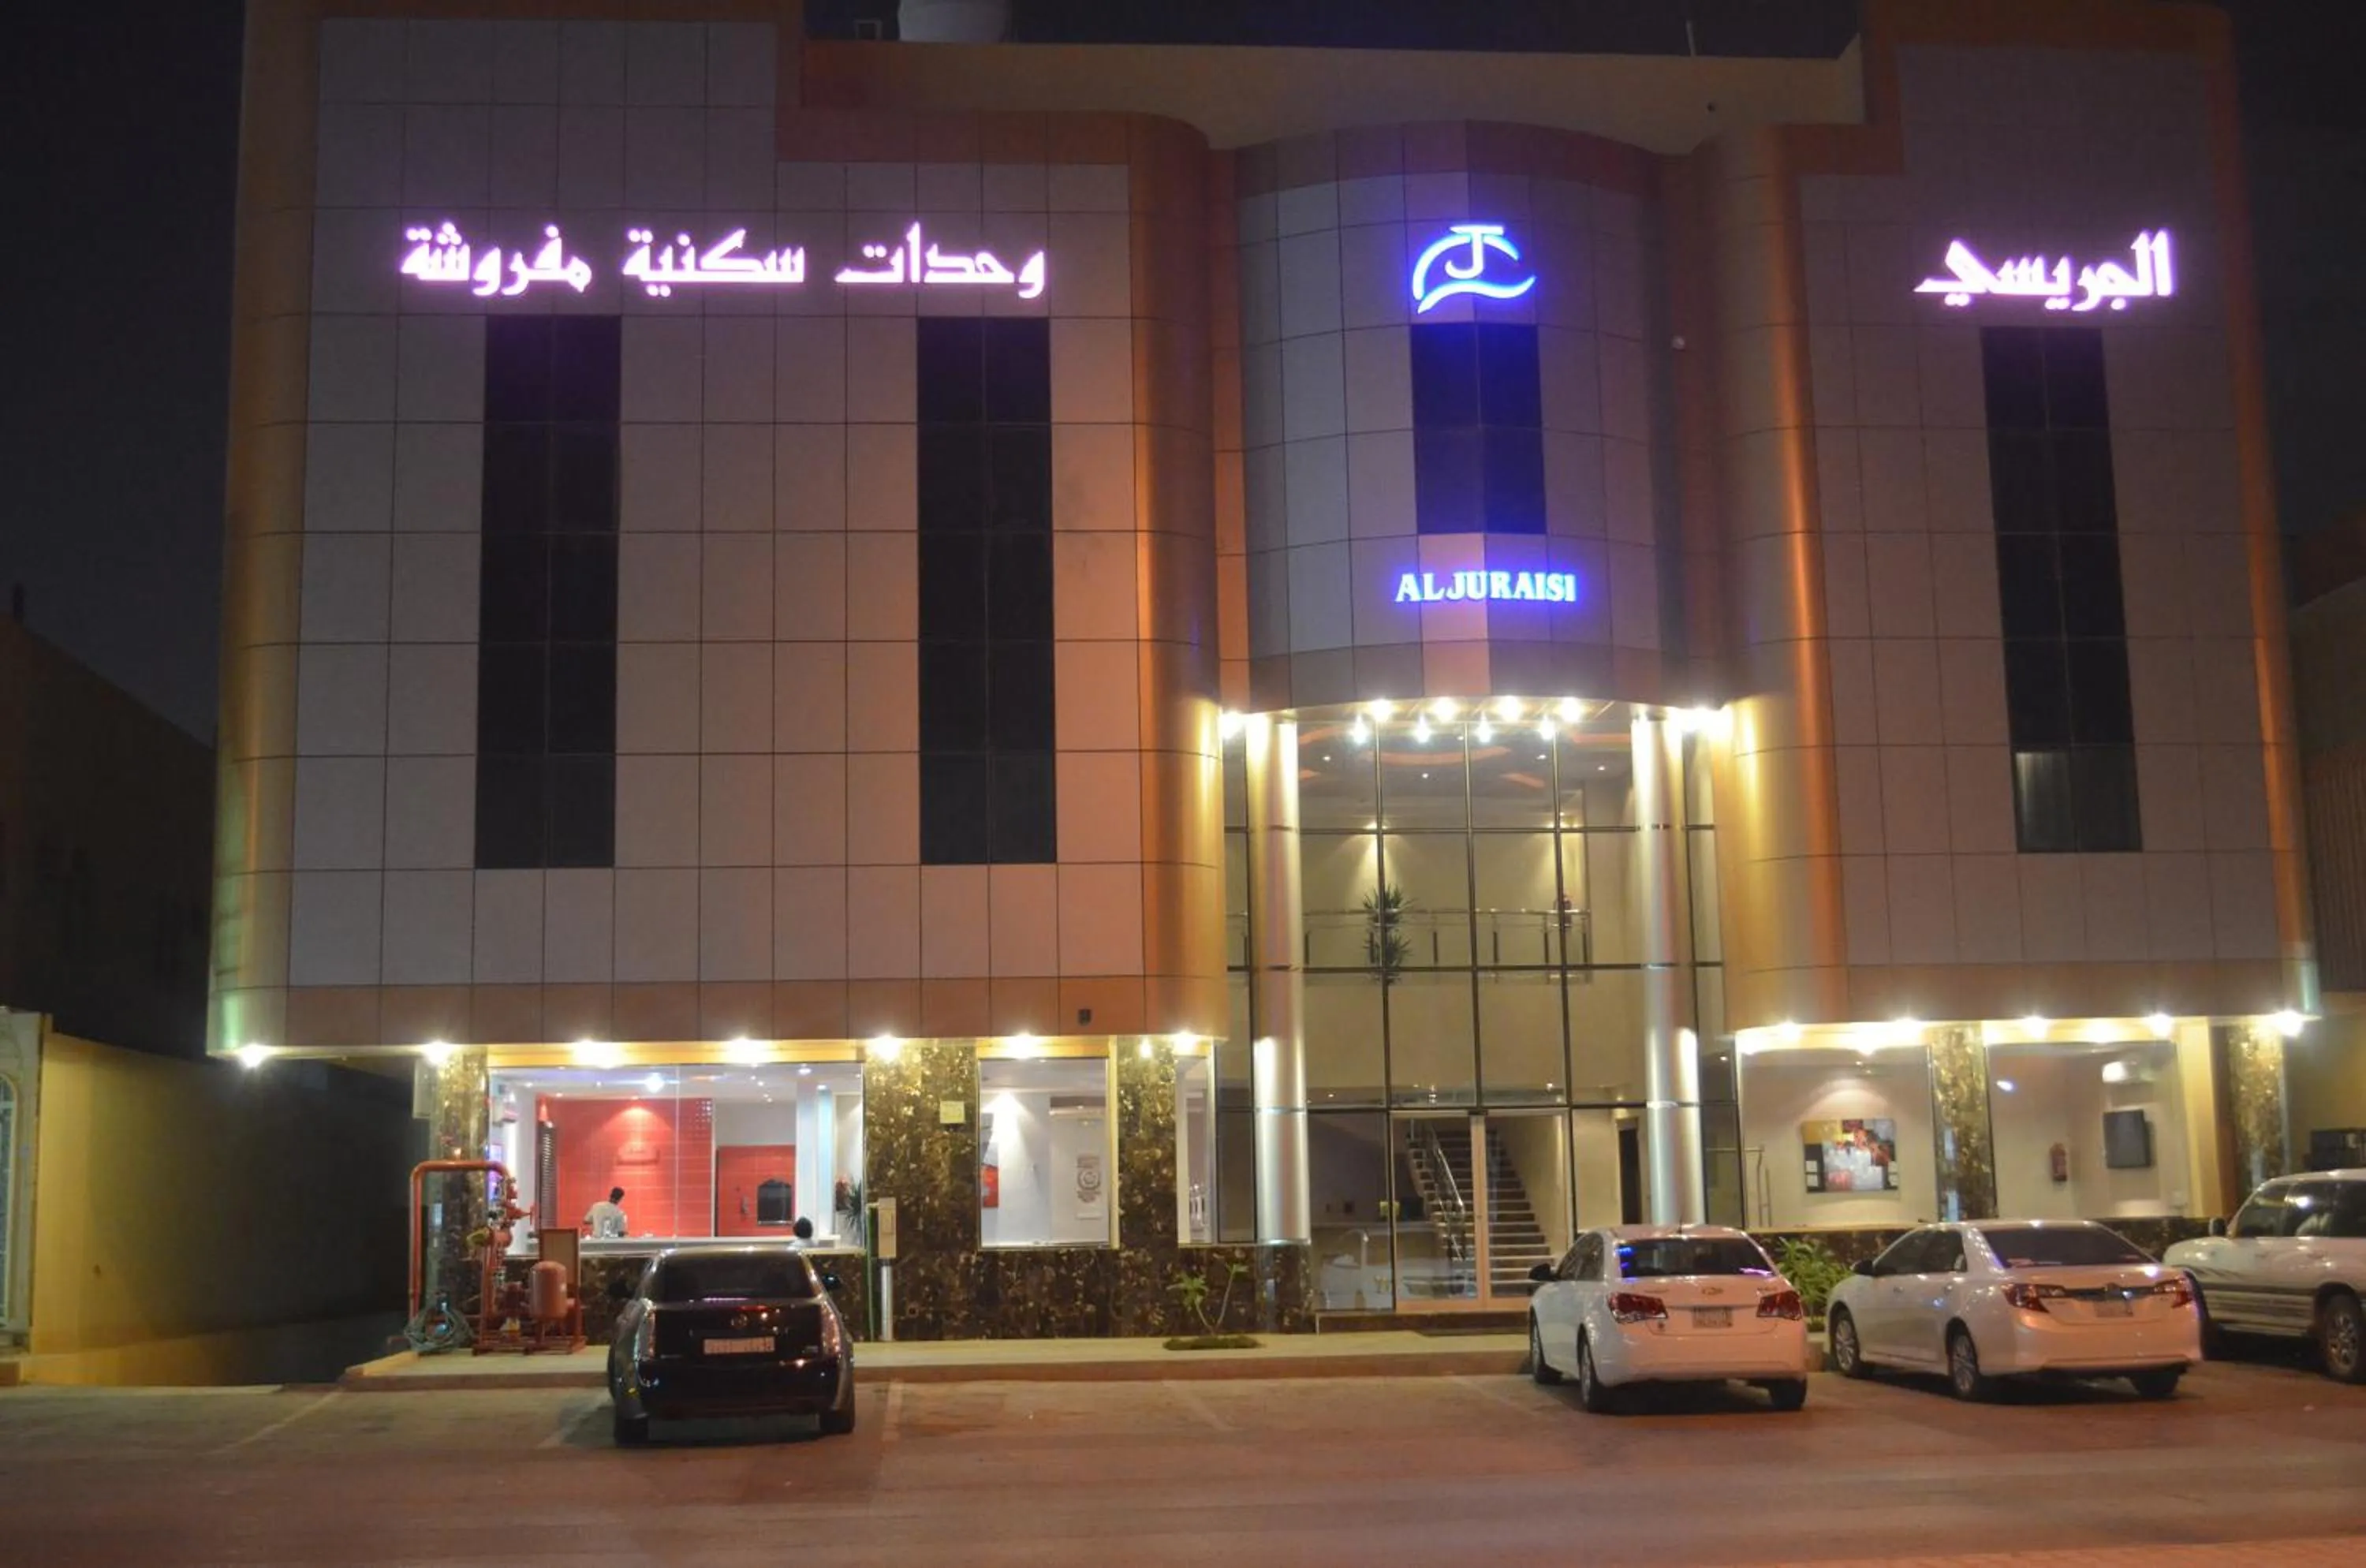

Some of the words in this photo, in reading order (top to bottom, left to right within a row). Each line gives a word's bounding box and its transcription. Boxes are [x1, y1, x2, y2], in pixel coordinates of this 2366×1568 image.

[401, 222, 592, 297] مفروشة
[621, 229, 805, 297] سكنية
[834, 222, 1045, 299] وحدات
[1913, 230, 2174, 312] الجريسي
